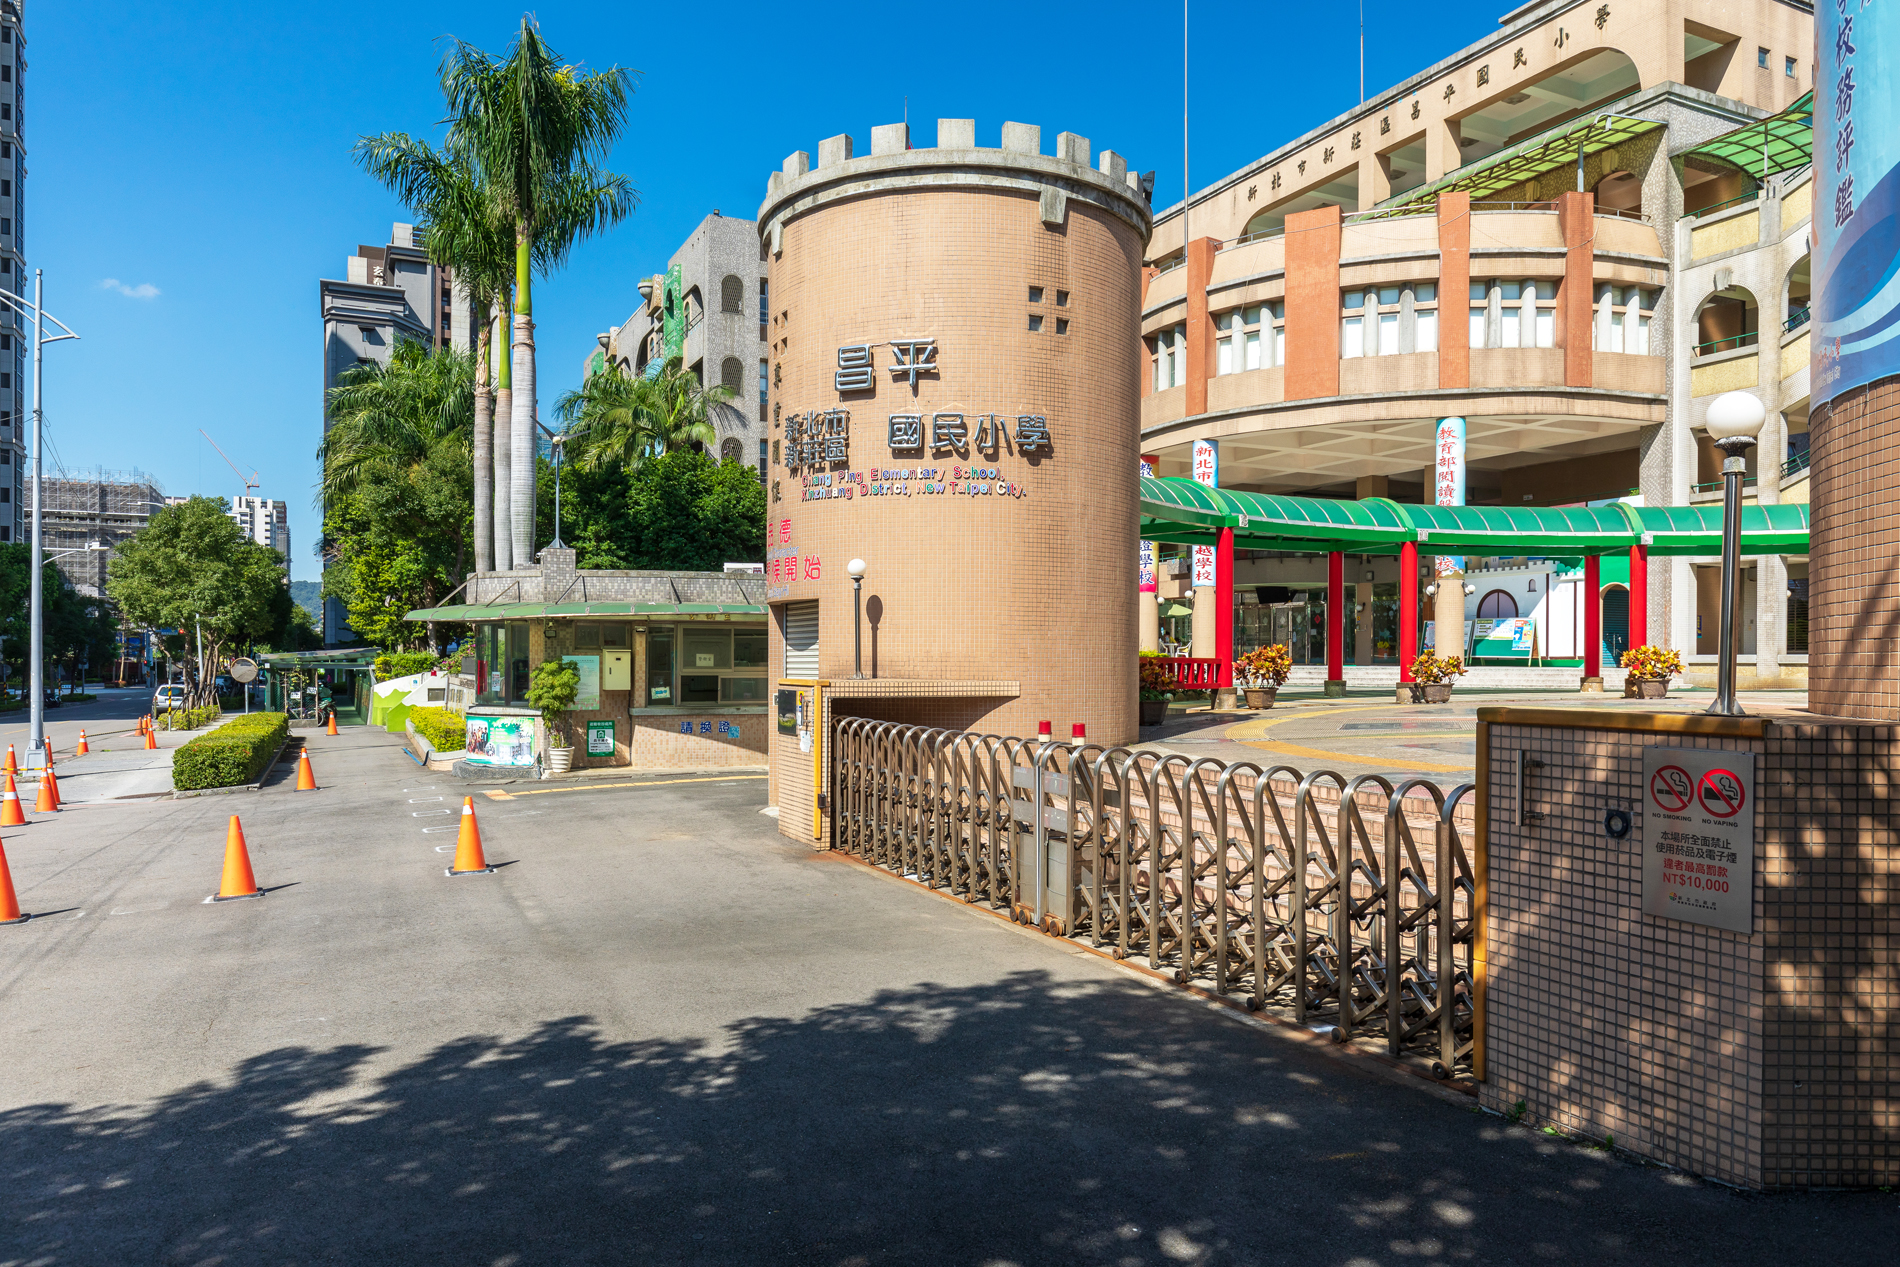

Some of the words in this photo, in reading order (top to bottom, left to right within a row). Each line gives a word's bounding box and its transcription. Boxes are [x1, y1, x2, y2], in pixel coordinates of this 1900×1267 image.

[1247, 3, 1610, 201] 新北市新莊區昌平國民小學
[834, 338, 937, 391] 昌平
[784, 407, 848, 440] 新北市
[888, 412, 1050, 451] 國民小學
[784, 435, 848, 469] 新莊區
[802, 473, 832, 487] Chang
[838, 470, 862, 484] Ping
[870, 466, 945, 481] Elementary
[953, 465, 1005, 482] School,
[1196, 446, 1213, 487] 新北市
[801, 484, 853, 500] Xinzhuang
[860, 482, 911, 497] District,
[916, 482, 945, 494] New
[950, 481, 991, 497] Taipei
[996, 481, 1026, 497] City.
[768, 518, 792, 547] 品德
[681, 721, 730, 733] 請換證
[1662, 813, 1692, 822] SMOKING
[1712, 820, 1738, 828] VAPING
[1660, 831, 1732, 850] 本場所全面禁止
[1655, 842, 1737, 864] 使用菸品及電子煙
[1663, 858, 1728, 878] 違者最高罰款
[1662, 873, 1729, 893] NT$10,000
